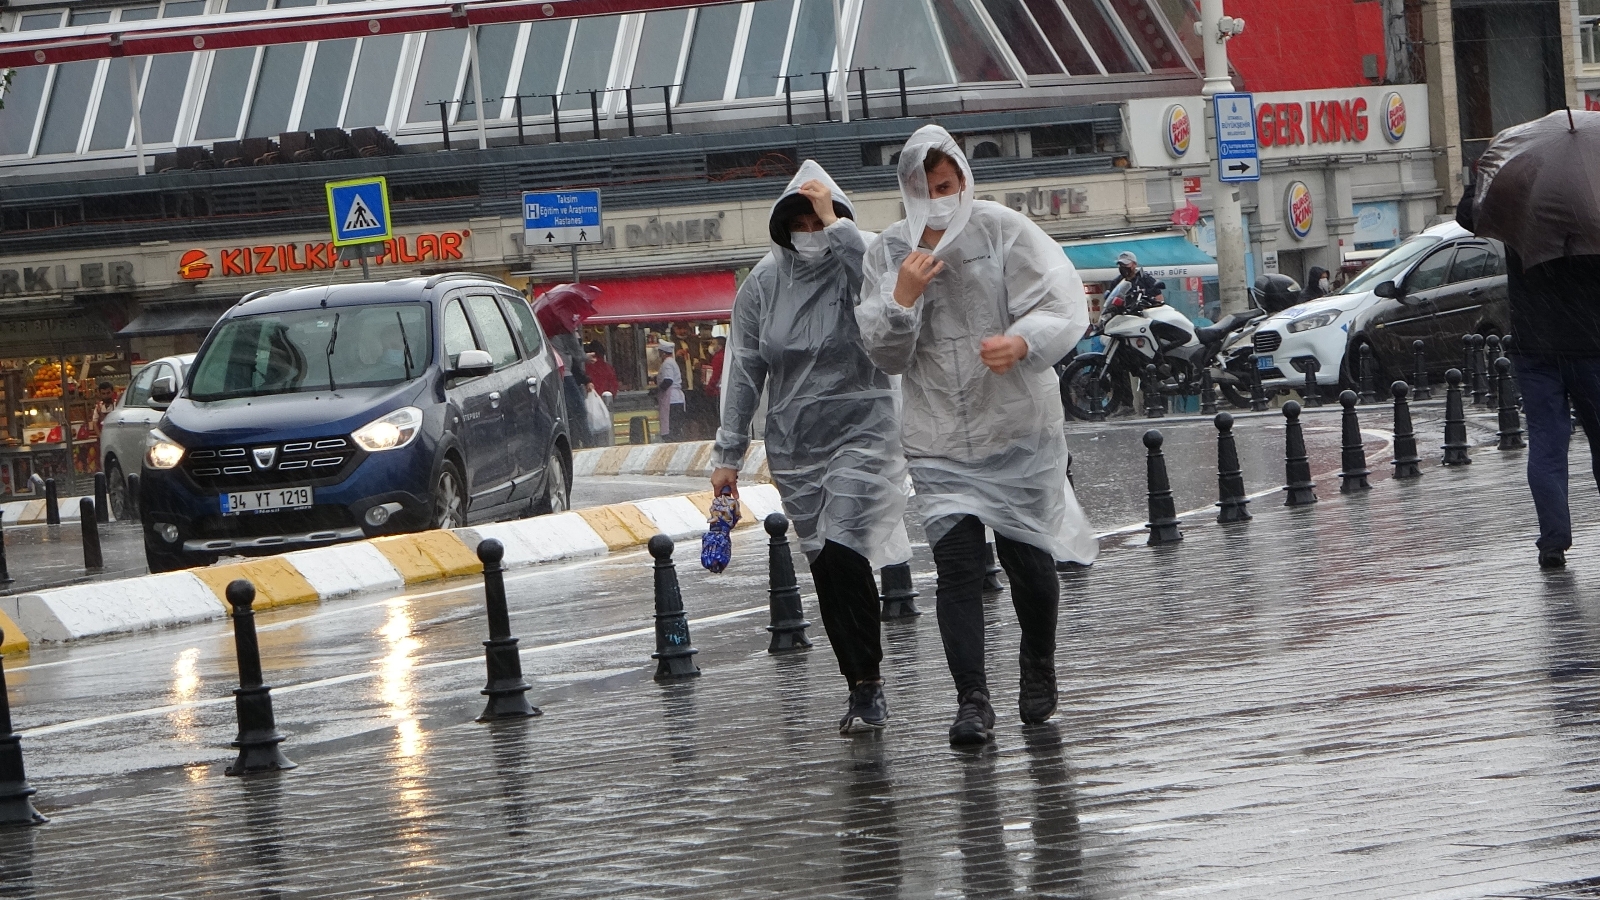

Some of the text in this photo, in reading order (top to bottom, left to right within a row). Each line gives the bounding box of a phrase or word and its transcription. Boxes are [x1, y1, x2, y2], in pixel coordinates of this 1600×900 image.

[1257, 97, 1368, 147] GER KING
[540, 206, 559, 217] Eğitim
[569, 205, 597, 214] Araştırma
[557, 195, 578, 203] Taksim
[1005, 186, 1090, 216] BÜFE
[554, 217, 583, 225] Hastanesi
[625, 216, 722, 248] DÖNER
[220, 232, 463, 276] KIZILKAALAR
[230, 494, 246, 509] 34
[256, 492, 270, 507] YT
[279, 489, 308, 505] 1219
